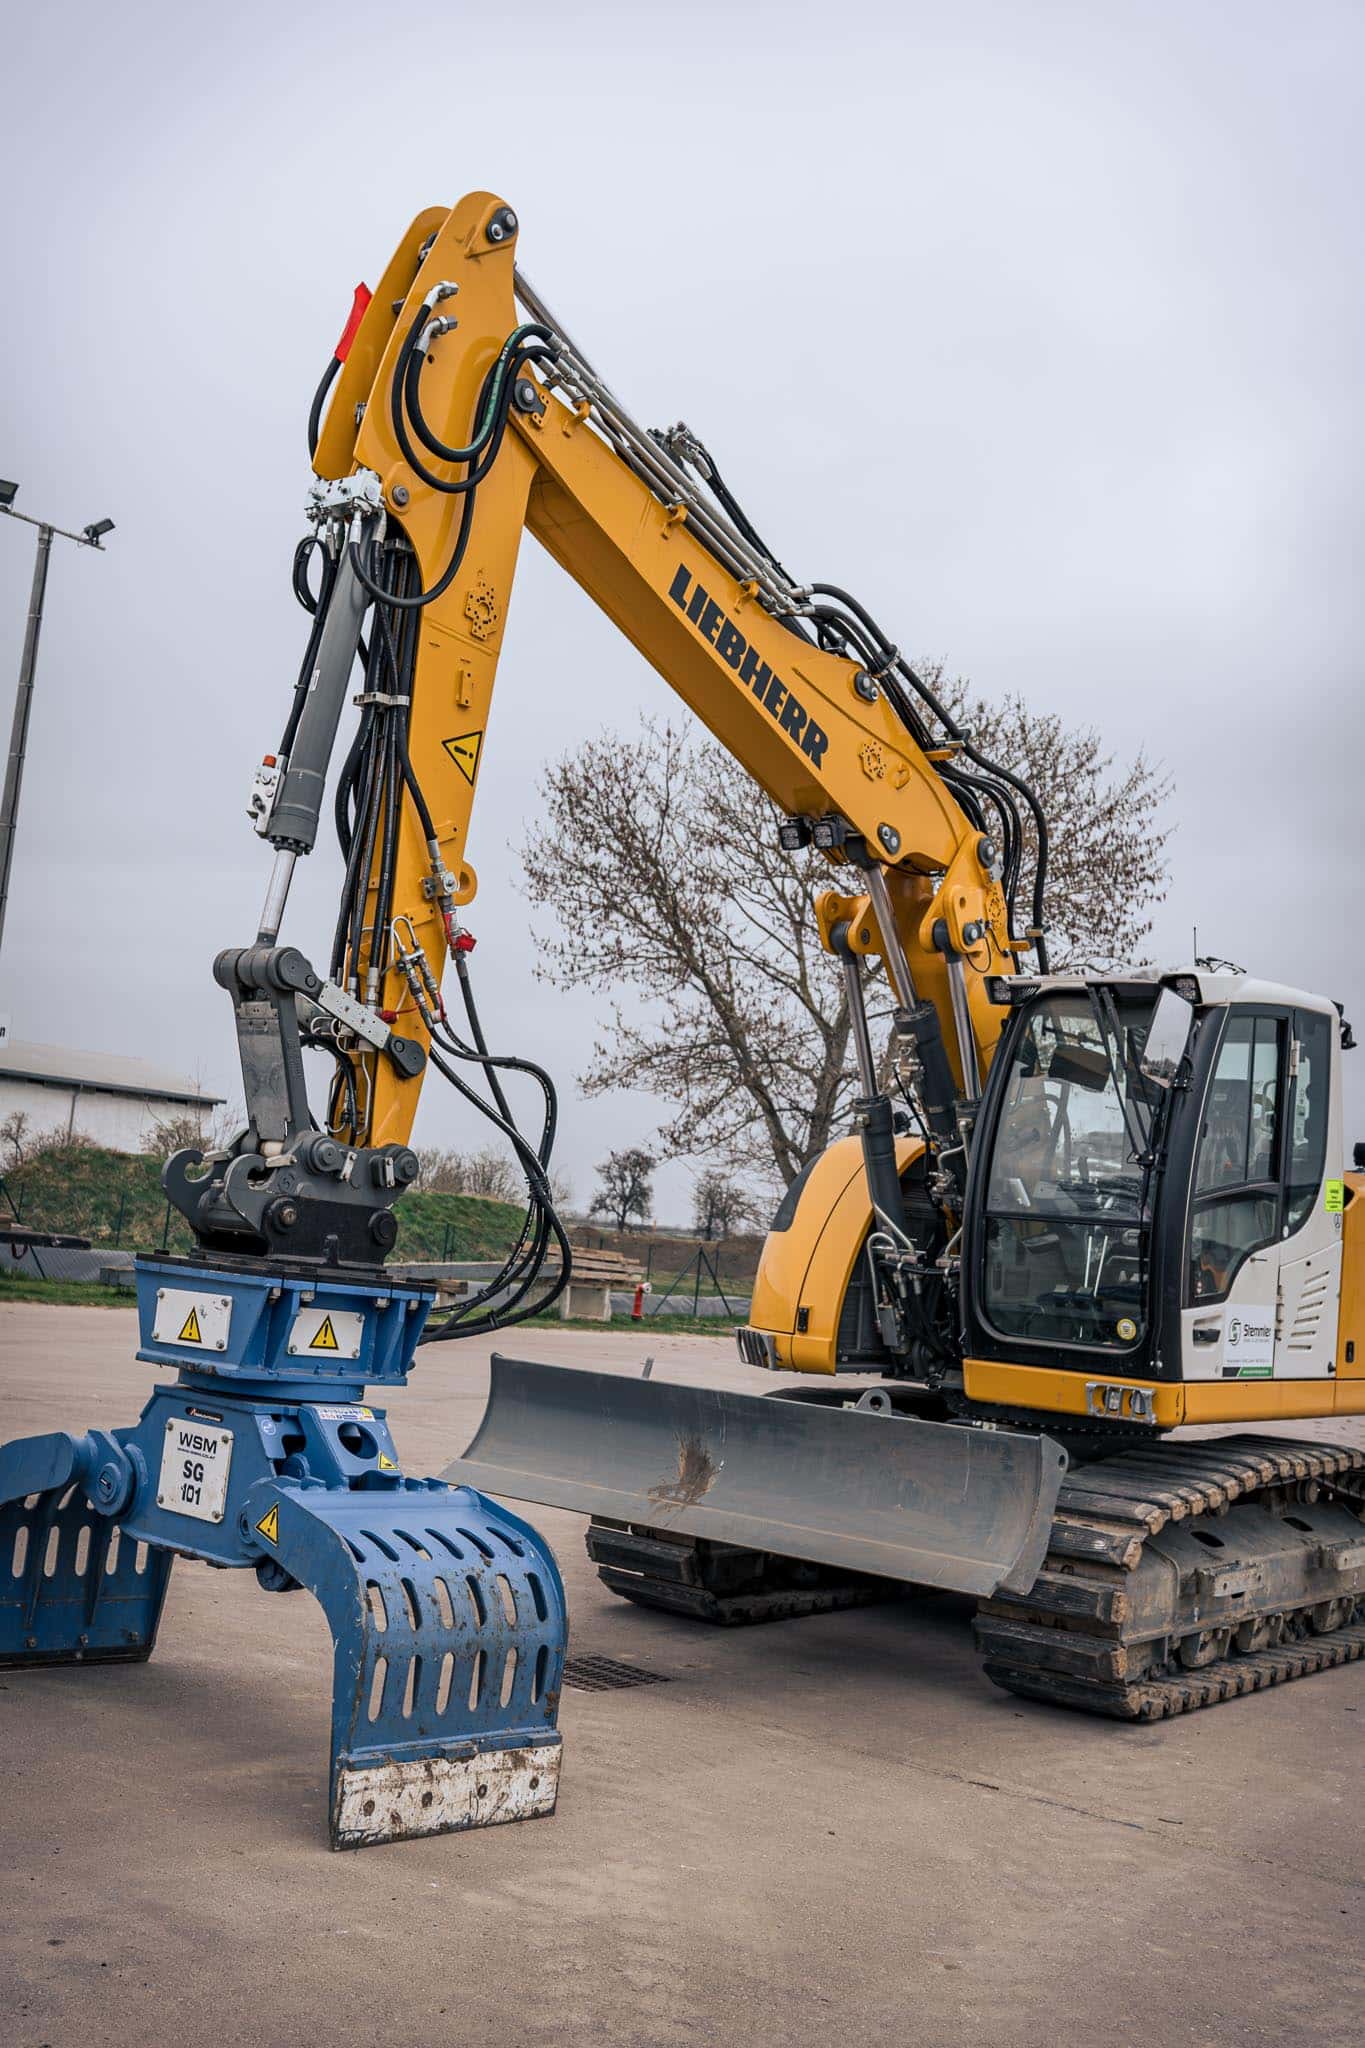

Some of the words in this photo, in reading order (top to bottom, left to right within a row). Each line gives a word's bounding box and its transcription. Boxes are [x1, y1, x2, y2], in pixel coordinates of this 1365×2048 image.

[668, 563, 829, 771] LIEBHERR
[180, 1431, 218, 1454] WSM
[183, 1460, 204, 1482] SG
[181, 1483, 201, 1505] 101
